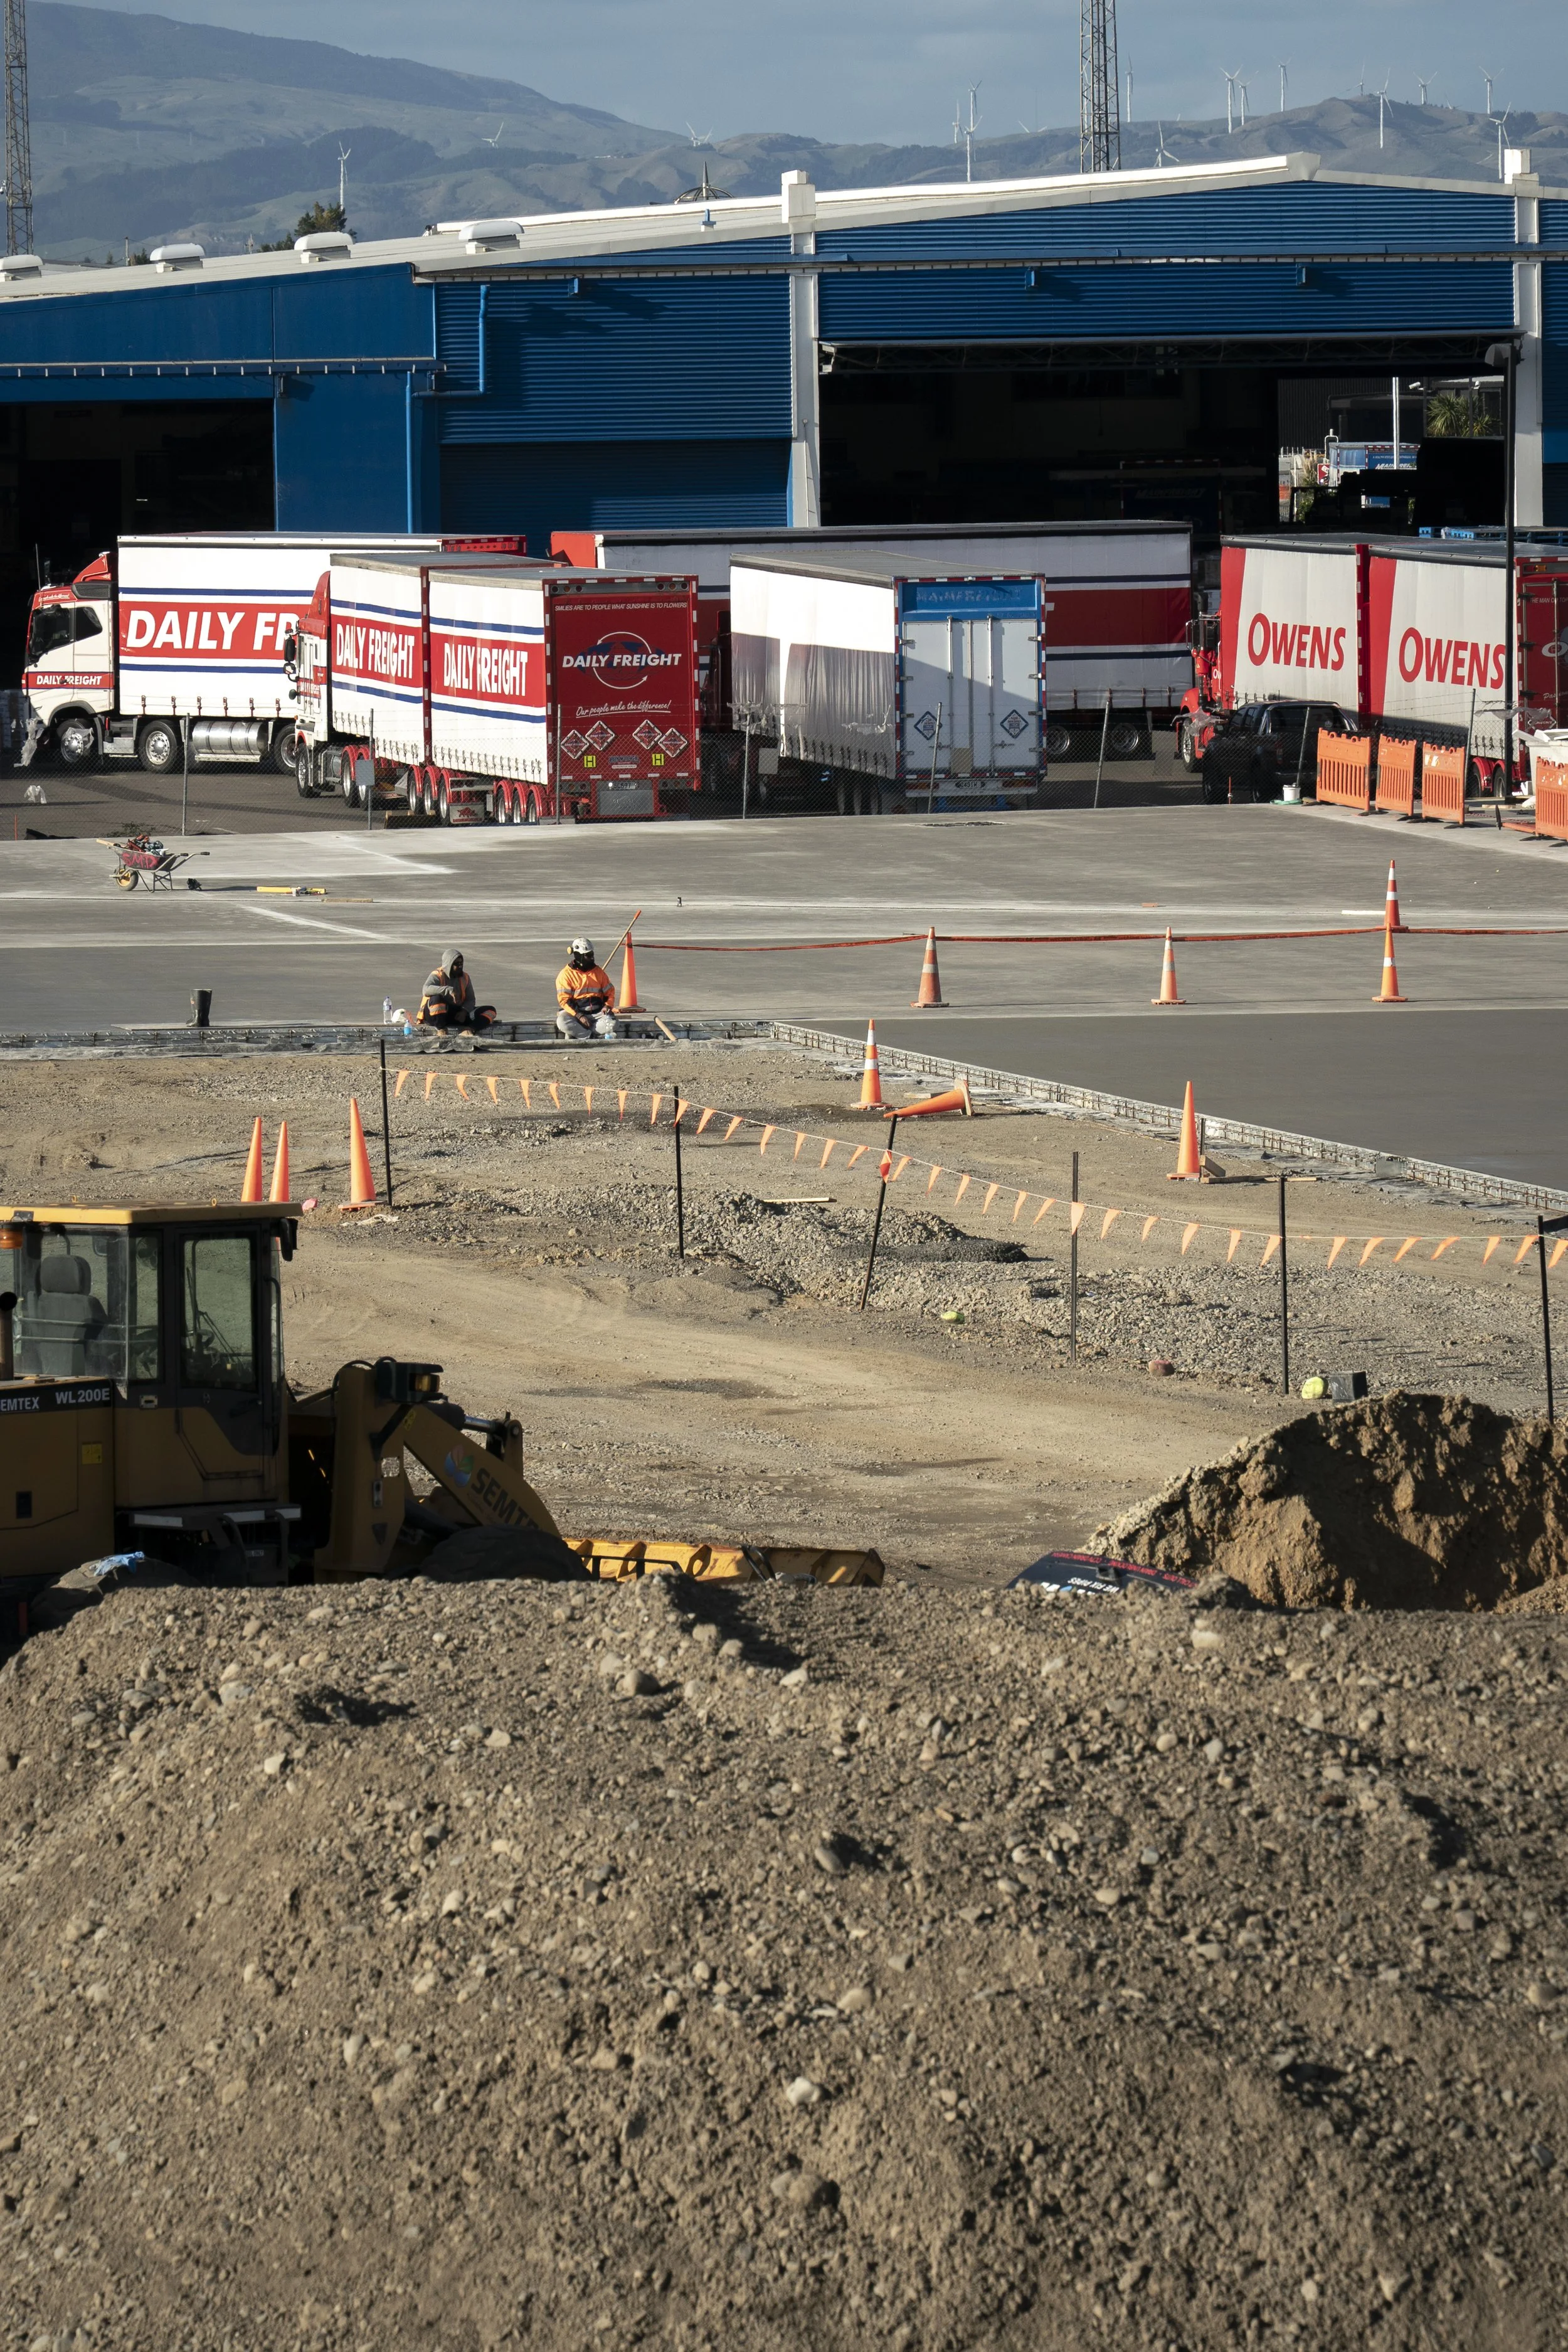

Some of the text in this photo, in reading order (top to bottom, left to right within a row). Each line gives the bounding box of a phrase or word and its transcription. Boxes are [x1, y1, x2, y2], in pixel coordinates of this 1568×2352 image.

[126, 610, 245, 650] DAILY
[1248, 612, 1346, 671] OWENS
[336, 623, 415, 679] DAILY FREIGHT
[562, 653, 682, 668] DAILY FREIGHT
[1399, 627, 1506, 689] OWENS
[36, 675, 102, 686] DAILY FREIGHT
[443, 642, 528, 697] DAILY FREIGHT
[576, 699, 672, 718] Our people make the difference!
[586, 756, 594, 767] H
[654, 754, 662, 765] H
